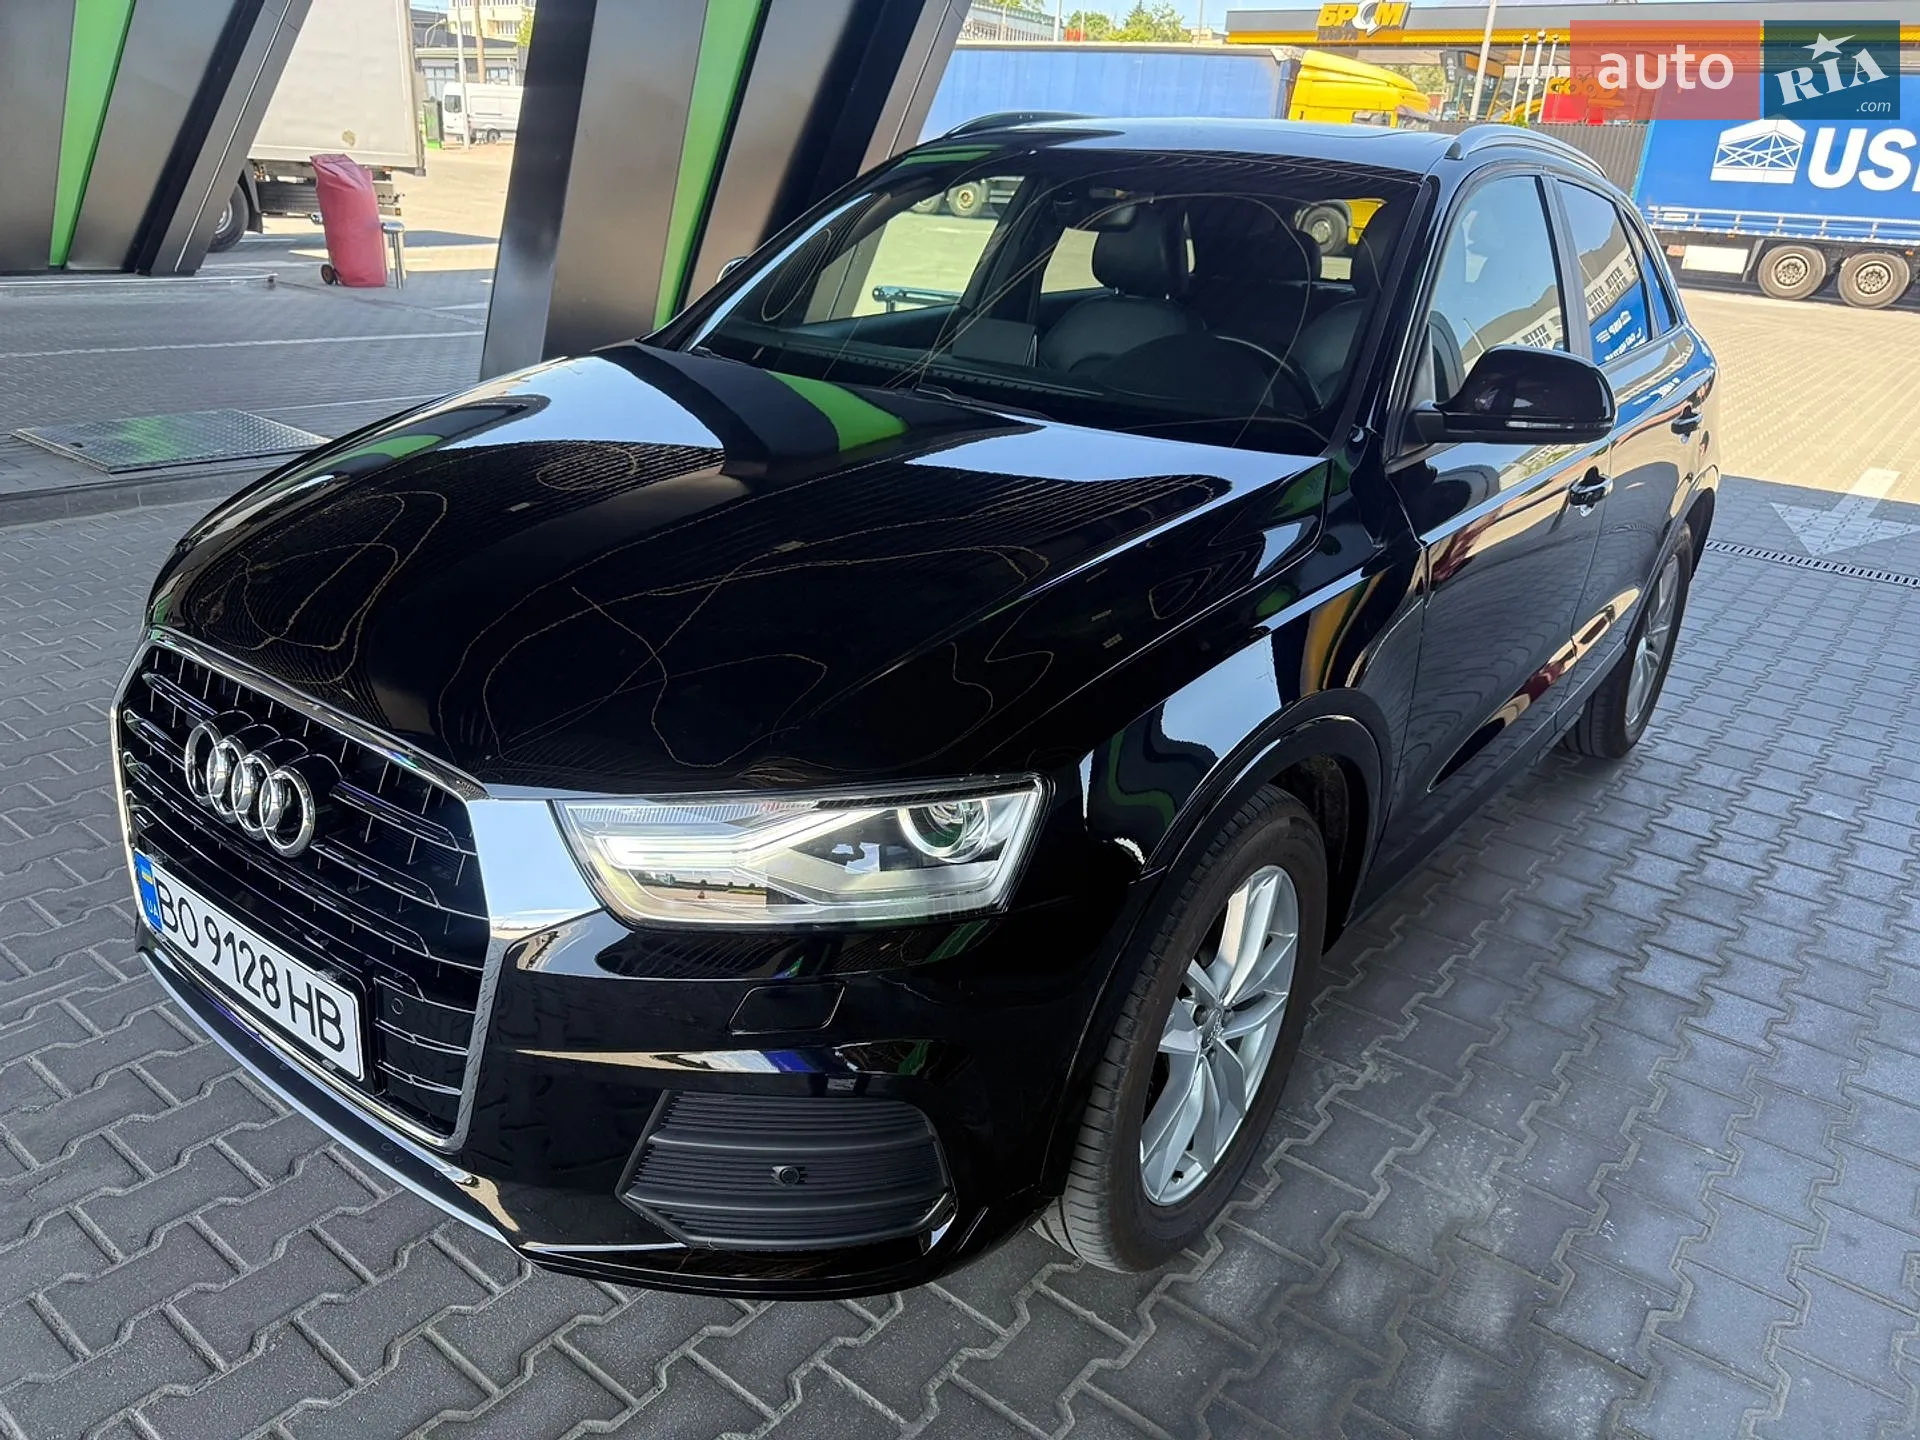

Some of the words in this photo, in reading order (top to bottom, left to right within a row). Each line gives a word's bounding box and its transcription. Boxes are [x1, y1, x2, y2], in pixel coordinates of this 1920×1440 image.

[1808, 127, 1920, 192] US
[154, 875, 199, 949] BO
[204, 914, 282, 1010] 9128
[286, 968, 346, 1053] HB
